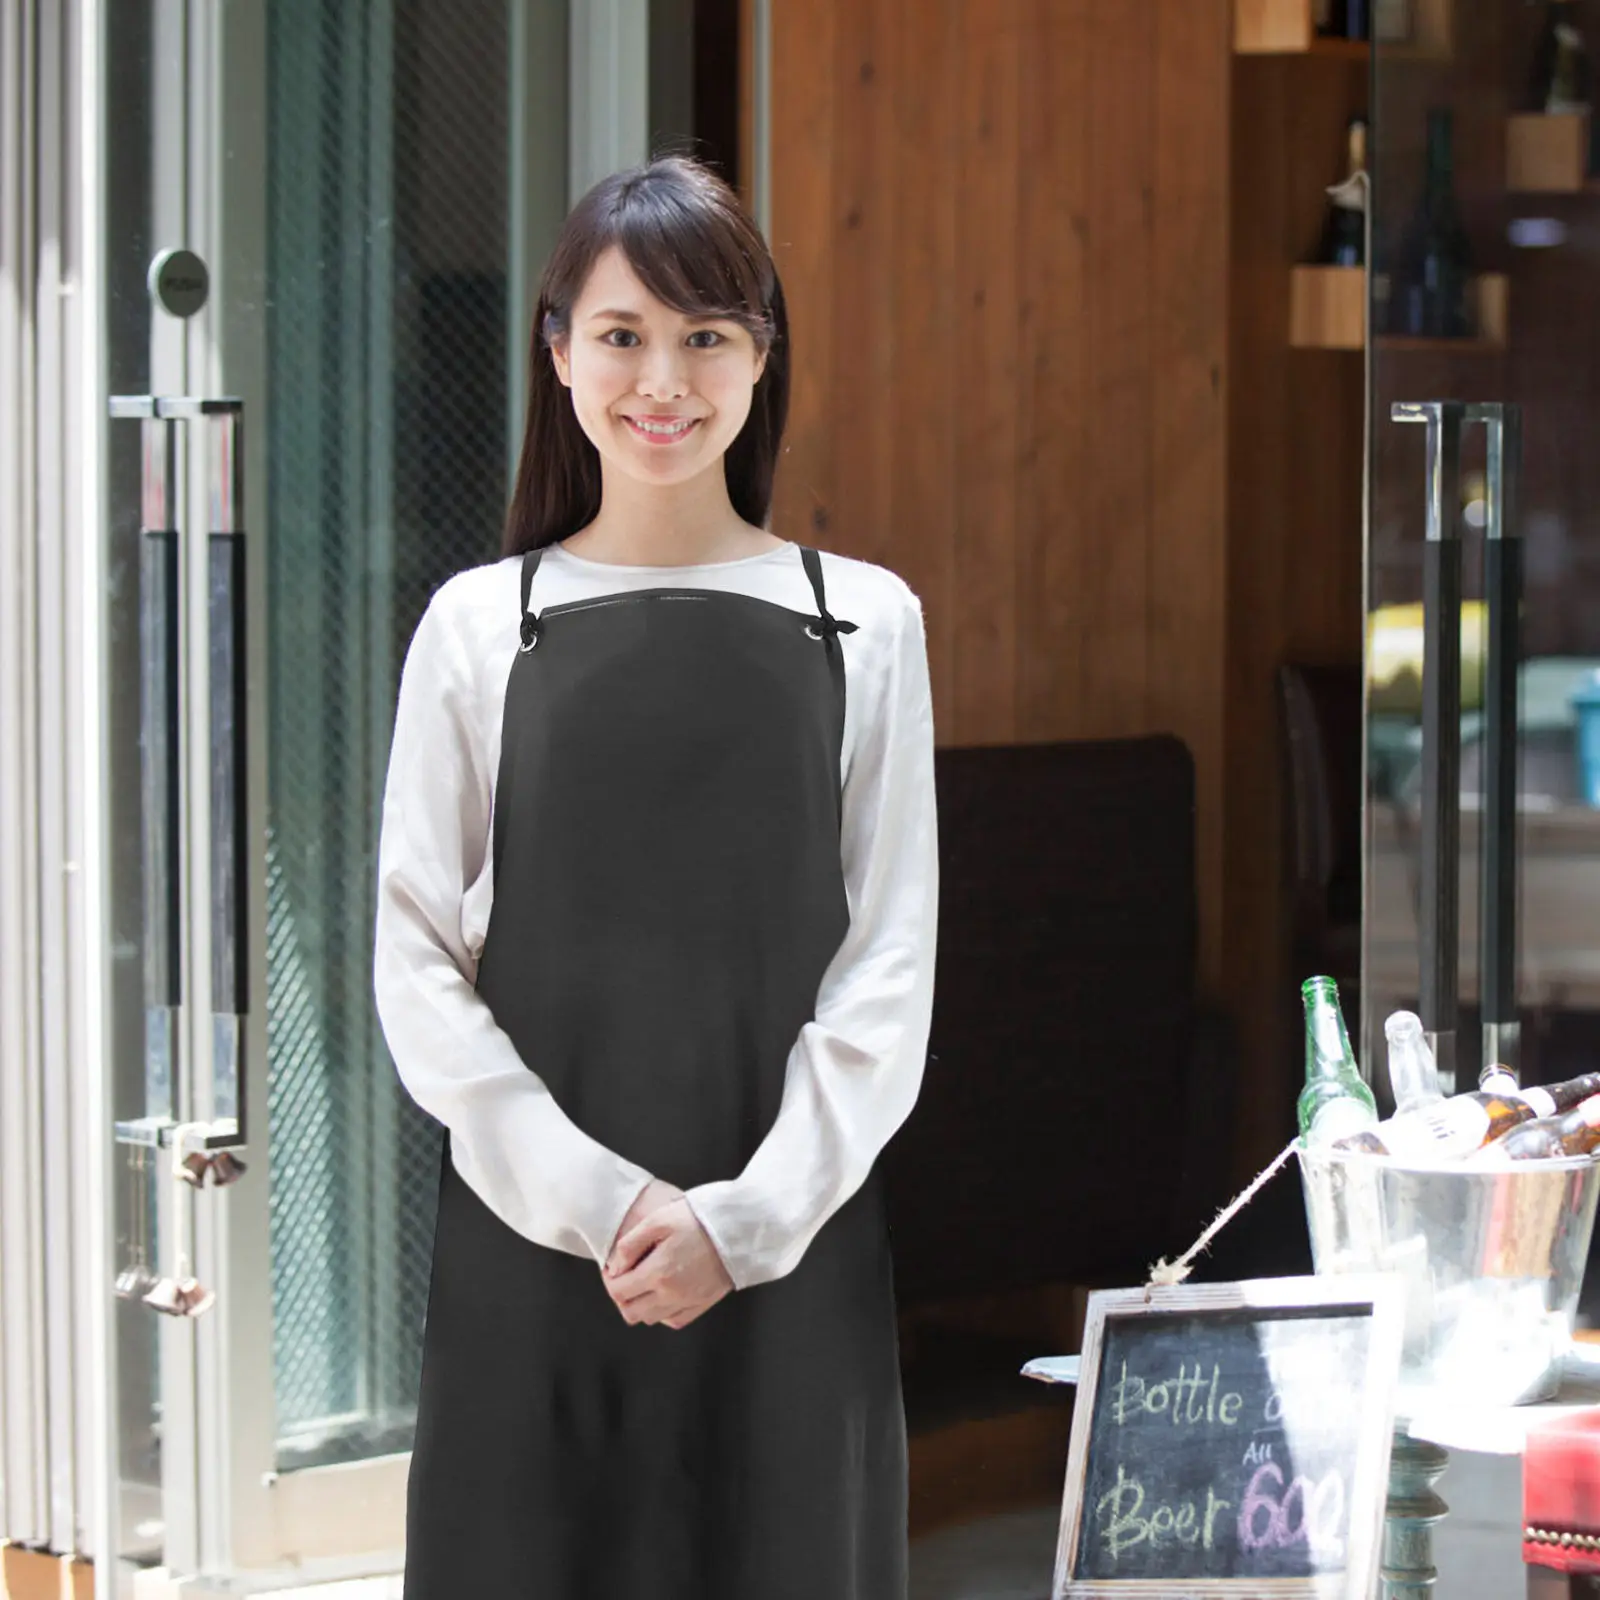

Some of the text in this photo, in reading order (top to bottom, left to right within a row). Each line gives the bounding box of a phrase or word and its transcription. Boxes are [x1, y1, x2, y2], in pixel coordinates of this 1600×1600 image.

[1111, 1359, 1242, 1426] Bottle
[1243, 1442, 1272, 1465] All
[1097, 1464, 1231, 1560] Beer
